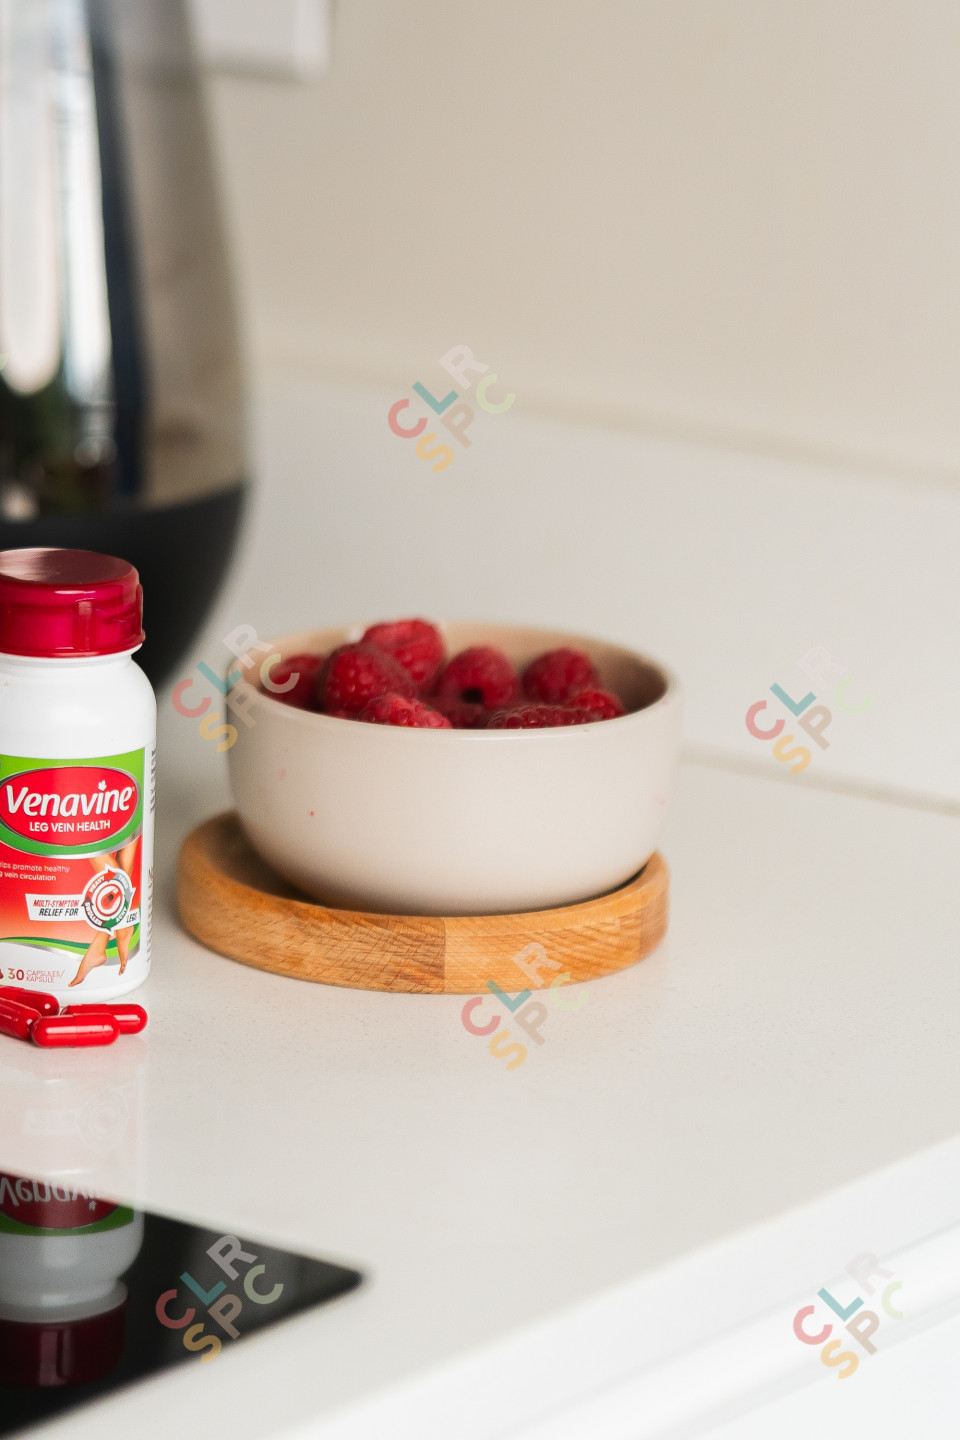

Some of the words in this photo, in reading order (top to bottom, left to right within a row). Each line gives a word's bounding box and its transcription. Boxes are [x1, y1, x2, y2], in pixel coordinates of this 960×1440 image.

[6, 780, 134, 817] Venavine
[29, 821, 49, 832] LEG
[51, 822, 75, 833] VEIN
[77, 820, 111, 832] HEALTH
[12, 864, 42, 872] promote
[44, 864, 70, 873] healthy
[4, 871, 18, 879] vein
[19, 873, 57, 881] circulation
[89, 875, 105, 893] HEAVY
[33, 899, 80, 908] MULTI-SYMPTOM
[39, 908, 63, 917] RELIEF
[64, 908, 79, 917] FOR
[7, 968, 24, 981] 30
